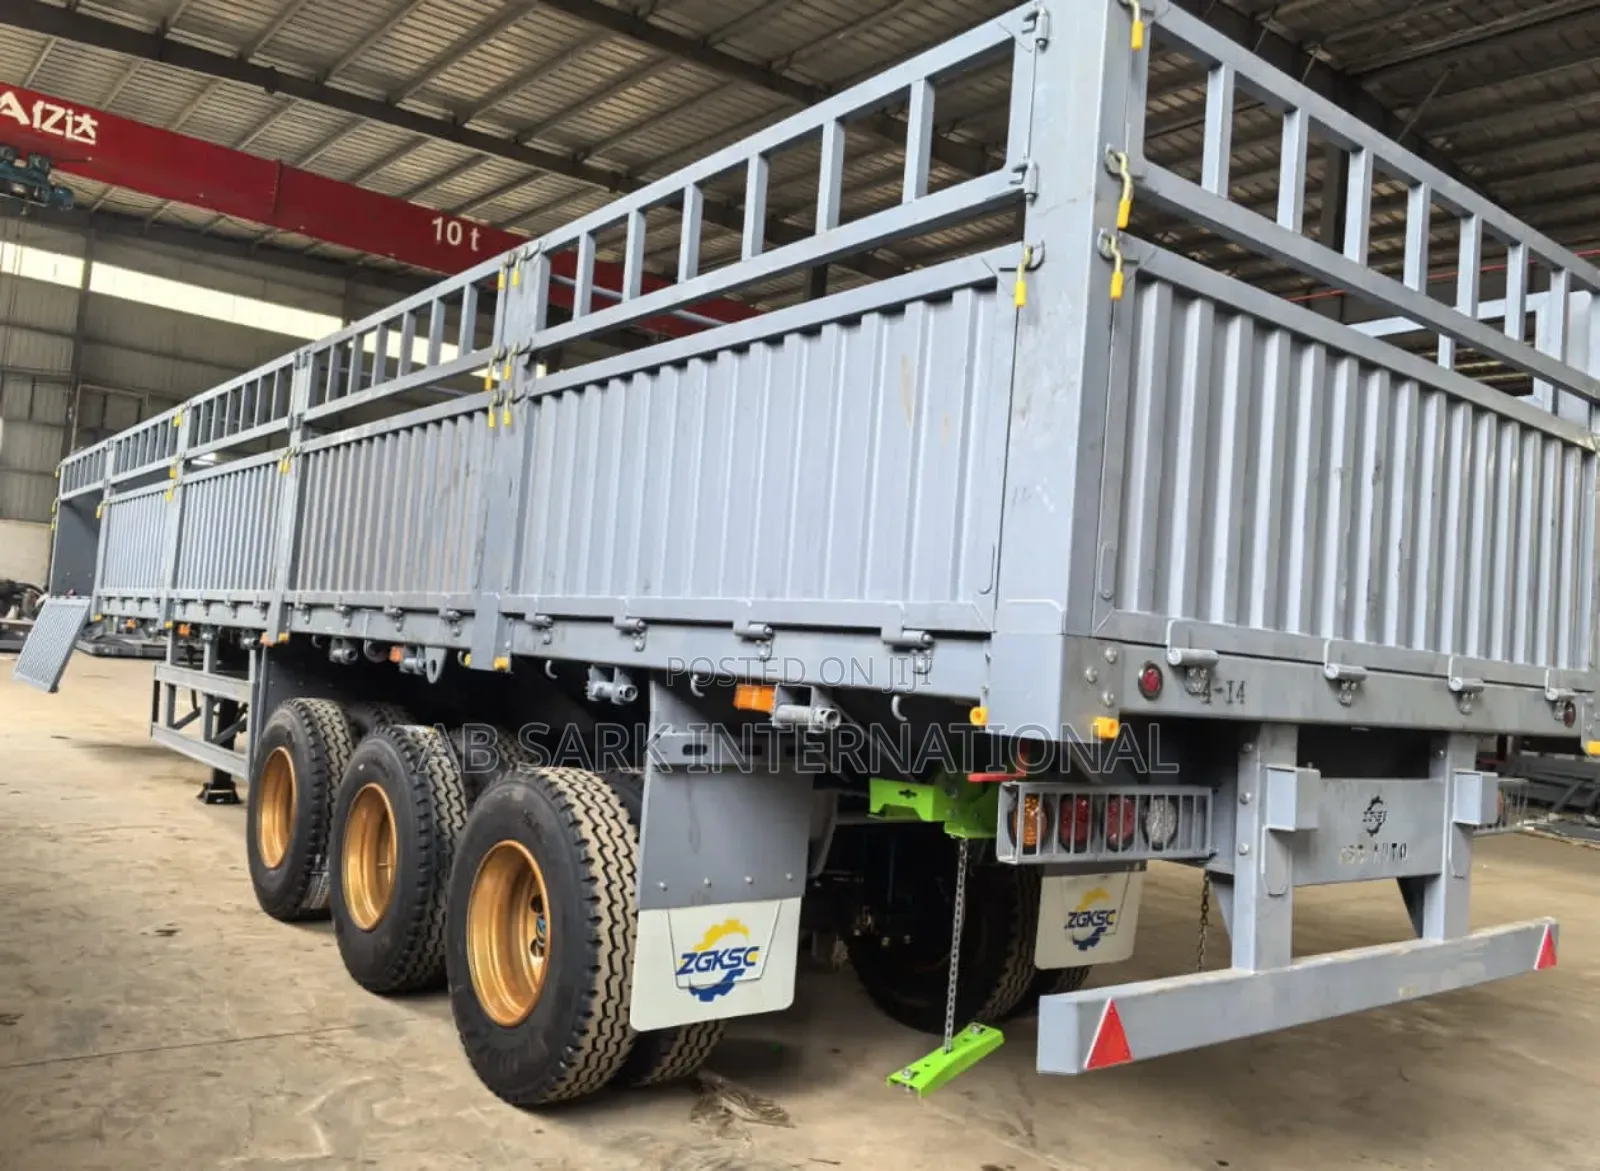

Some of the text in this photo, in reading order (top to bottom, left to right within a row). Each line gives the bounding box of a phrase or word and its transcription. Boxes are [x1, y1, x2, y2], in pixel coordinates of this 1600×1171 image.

[432, 216, 480, 252] 10 t
[1064, 908, 1117, 930] ZGKSC
[675, 945, 760, 976] ZGKSC
